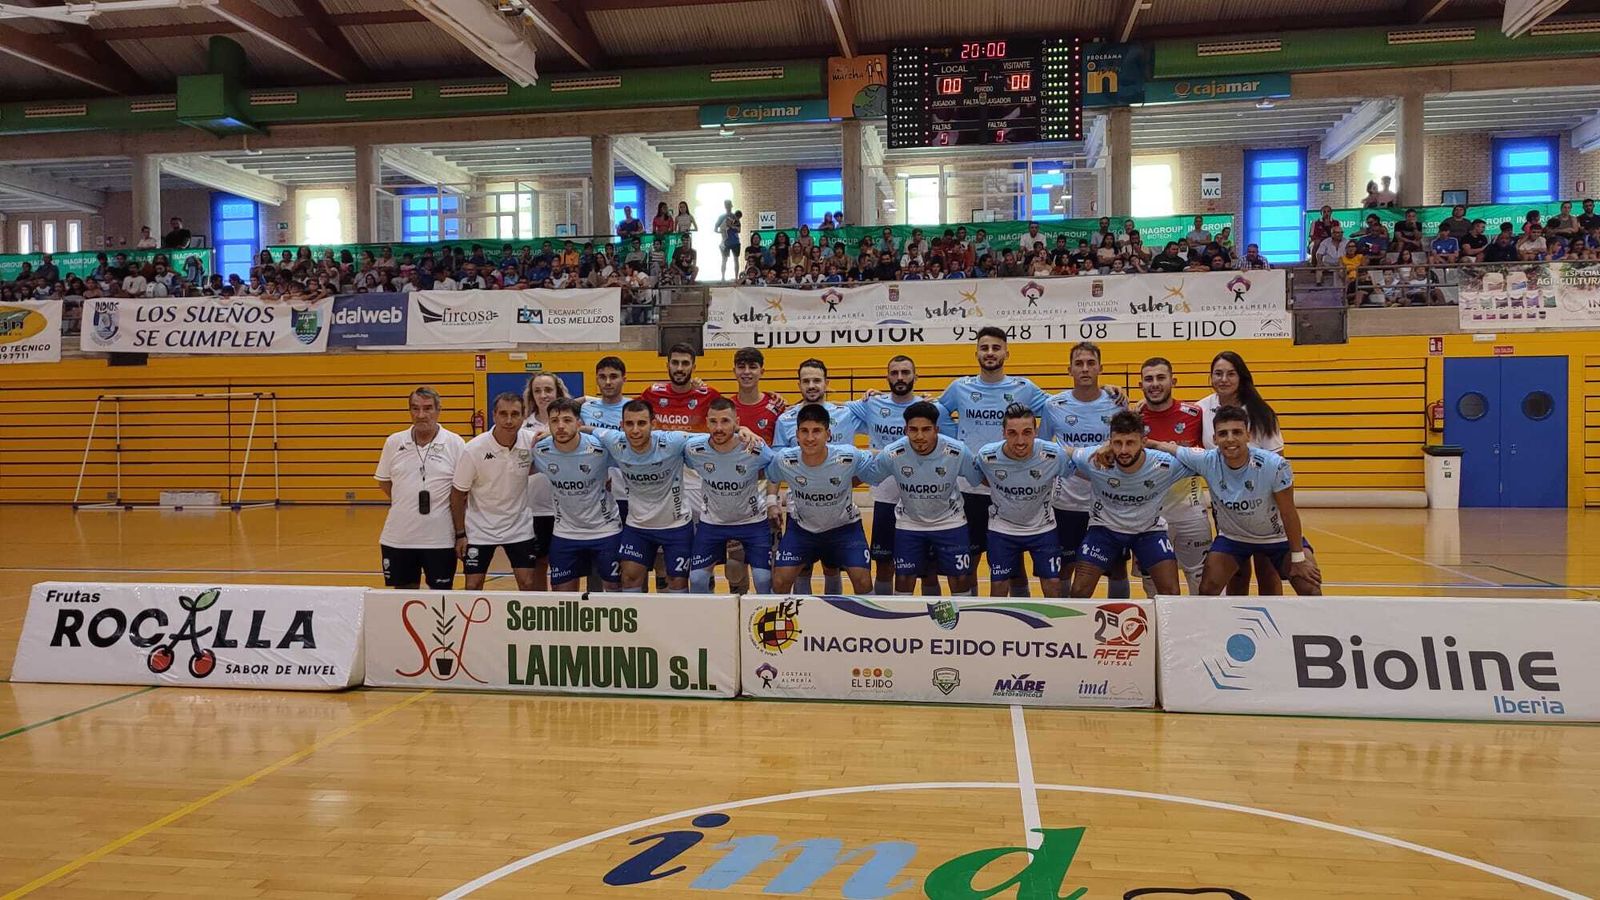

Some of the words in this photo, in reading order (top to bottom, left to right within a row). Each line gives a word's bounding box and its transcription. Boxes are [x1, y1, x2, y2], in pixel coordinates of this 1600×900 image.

[961, 42, 1006, 59] 20:00
[1086, 53, 1122, 61] PROGRAMA
[941, 65, 968, 73] LOCAL
[1003, 61, 1031, 69] VISITANTE
[943, 78, 962, 93] 00
[1011, 74, 1030, 90] 00
[1193, 80, 1260, 98] cajamar
[1020, 95, 1036, 103] FALTA
[742, 104, 802, 121] cajamar
[932, 123, 952, 131] FALTAS
[987, 121, 1007, 129] FALTAS
[1140, 225, 1183, 235] INAGROUP
[1187, 222, 1232, 233] INGROUP
[136, 305, 176, 323] LOS
[182, 301, 275, 324] SUEÑOS
[548, 307, 602, 316] EXCAVACIONES
[925, 300, 983, 318] sabores
[1129, 295, 1192, 315] sabores
[443, 308, 493, 322] fircosa
[547, 317, 566, 325] LOS
[568, 315, 615, 325] MELLIZOS
[733, 306, 788, 324] sabores
[133, 330, 162, 347] SE
[164, 330, 275, 347] CUMPLEN
[754, 330, 820, 348] EJIDO
[831, 328, 925, 344] MOTOR
[1044, 324, 1067, 340] 11
[1079, 323, 1107, 340] 08
[1137, 322, 1161, 339] EL
[1173, 320, 1237, 341] EJIDO
[965, 409, 1006, 420] INAGRO
[900, 482, 951, 494] INAGROUP
[1158, 539, 1174, 554] 14
[863, 549, 871, 563] 9
[954, 553, 970, 570] 30
[610, 561, 622, 576] 2
[675, 557, 690, 572] 24
[1049, 556, 1061, 572] 19
[46, 590, 101, 603] Frutas
[507, 600, 638, 633] Semilleros
[49, 606, 317, 655] ROCALLA
[803, 636, 924, 654] INAGROUP
[930, 638, 996, 656] EJIDO
[1002, 641, 1088, 660] FUTSAL
[225, 664, 269, 675] SABOR
[274, 664, 292, 675] DE
[297, 664, 337, 676] NIVEL
[507, 643, 658, 689] LAIMUND
[1291, 633, 1561, 693] Bioline
[851, 679, 862, 688] EL
[865, 679, 893, 689] EJIDO
[995, 679, 1046, 692] MABE
[1078, 679, 1109, 696] imd
[1493, 694, 1566, 716] Iberia
[603, 813, 1087, 900] imd
